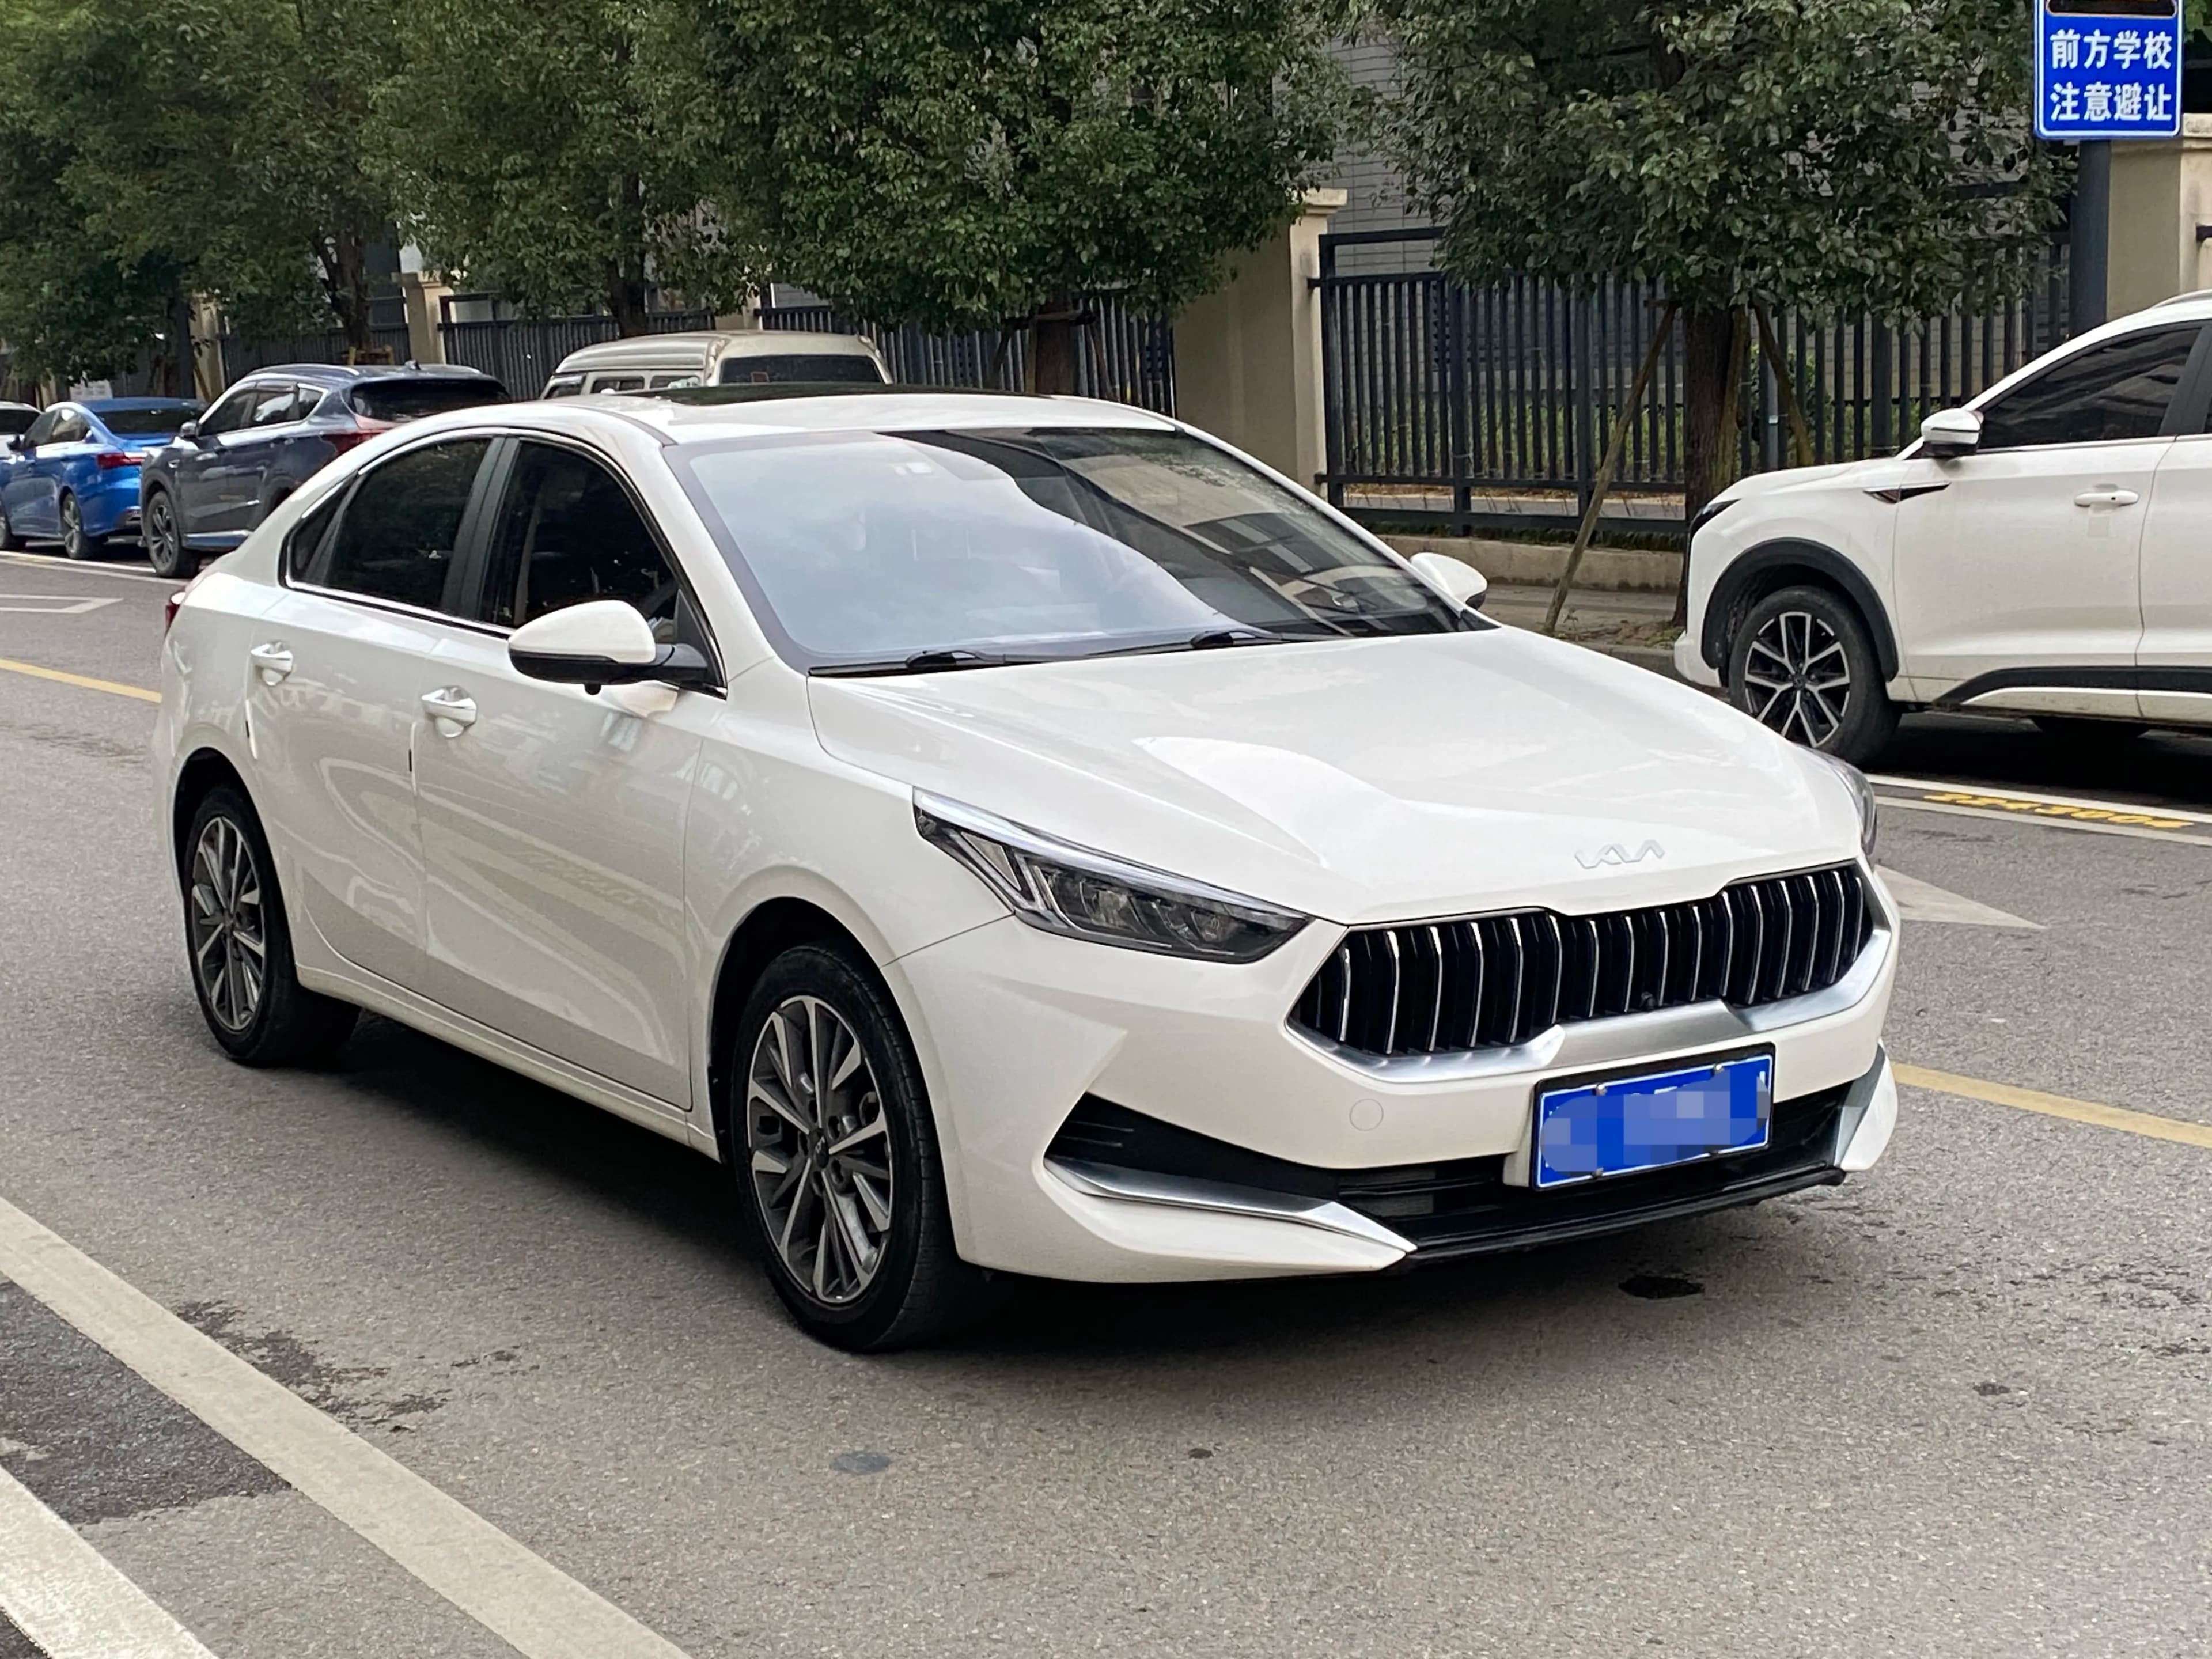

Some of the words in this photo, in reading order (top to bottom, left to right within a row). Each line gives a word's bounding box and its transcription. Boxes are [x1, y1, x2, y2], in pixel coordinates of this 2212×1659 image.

[2050, 28, 2172, 70] 前方学校
[2050, 81, 2172, 122] 注意避让
